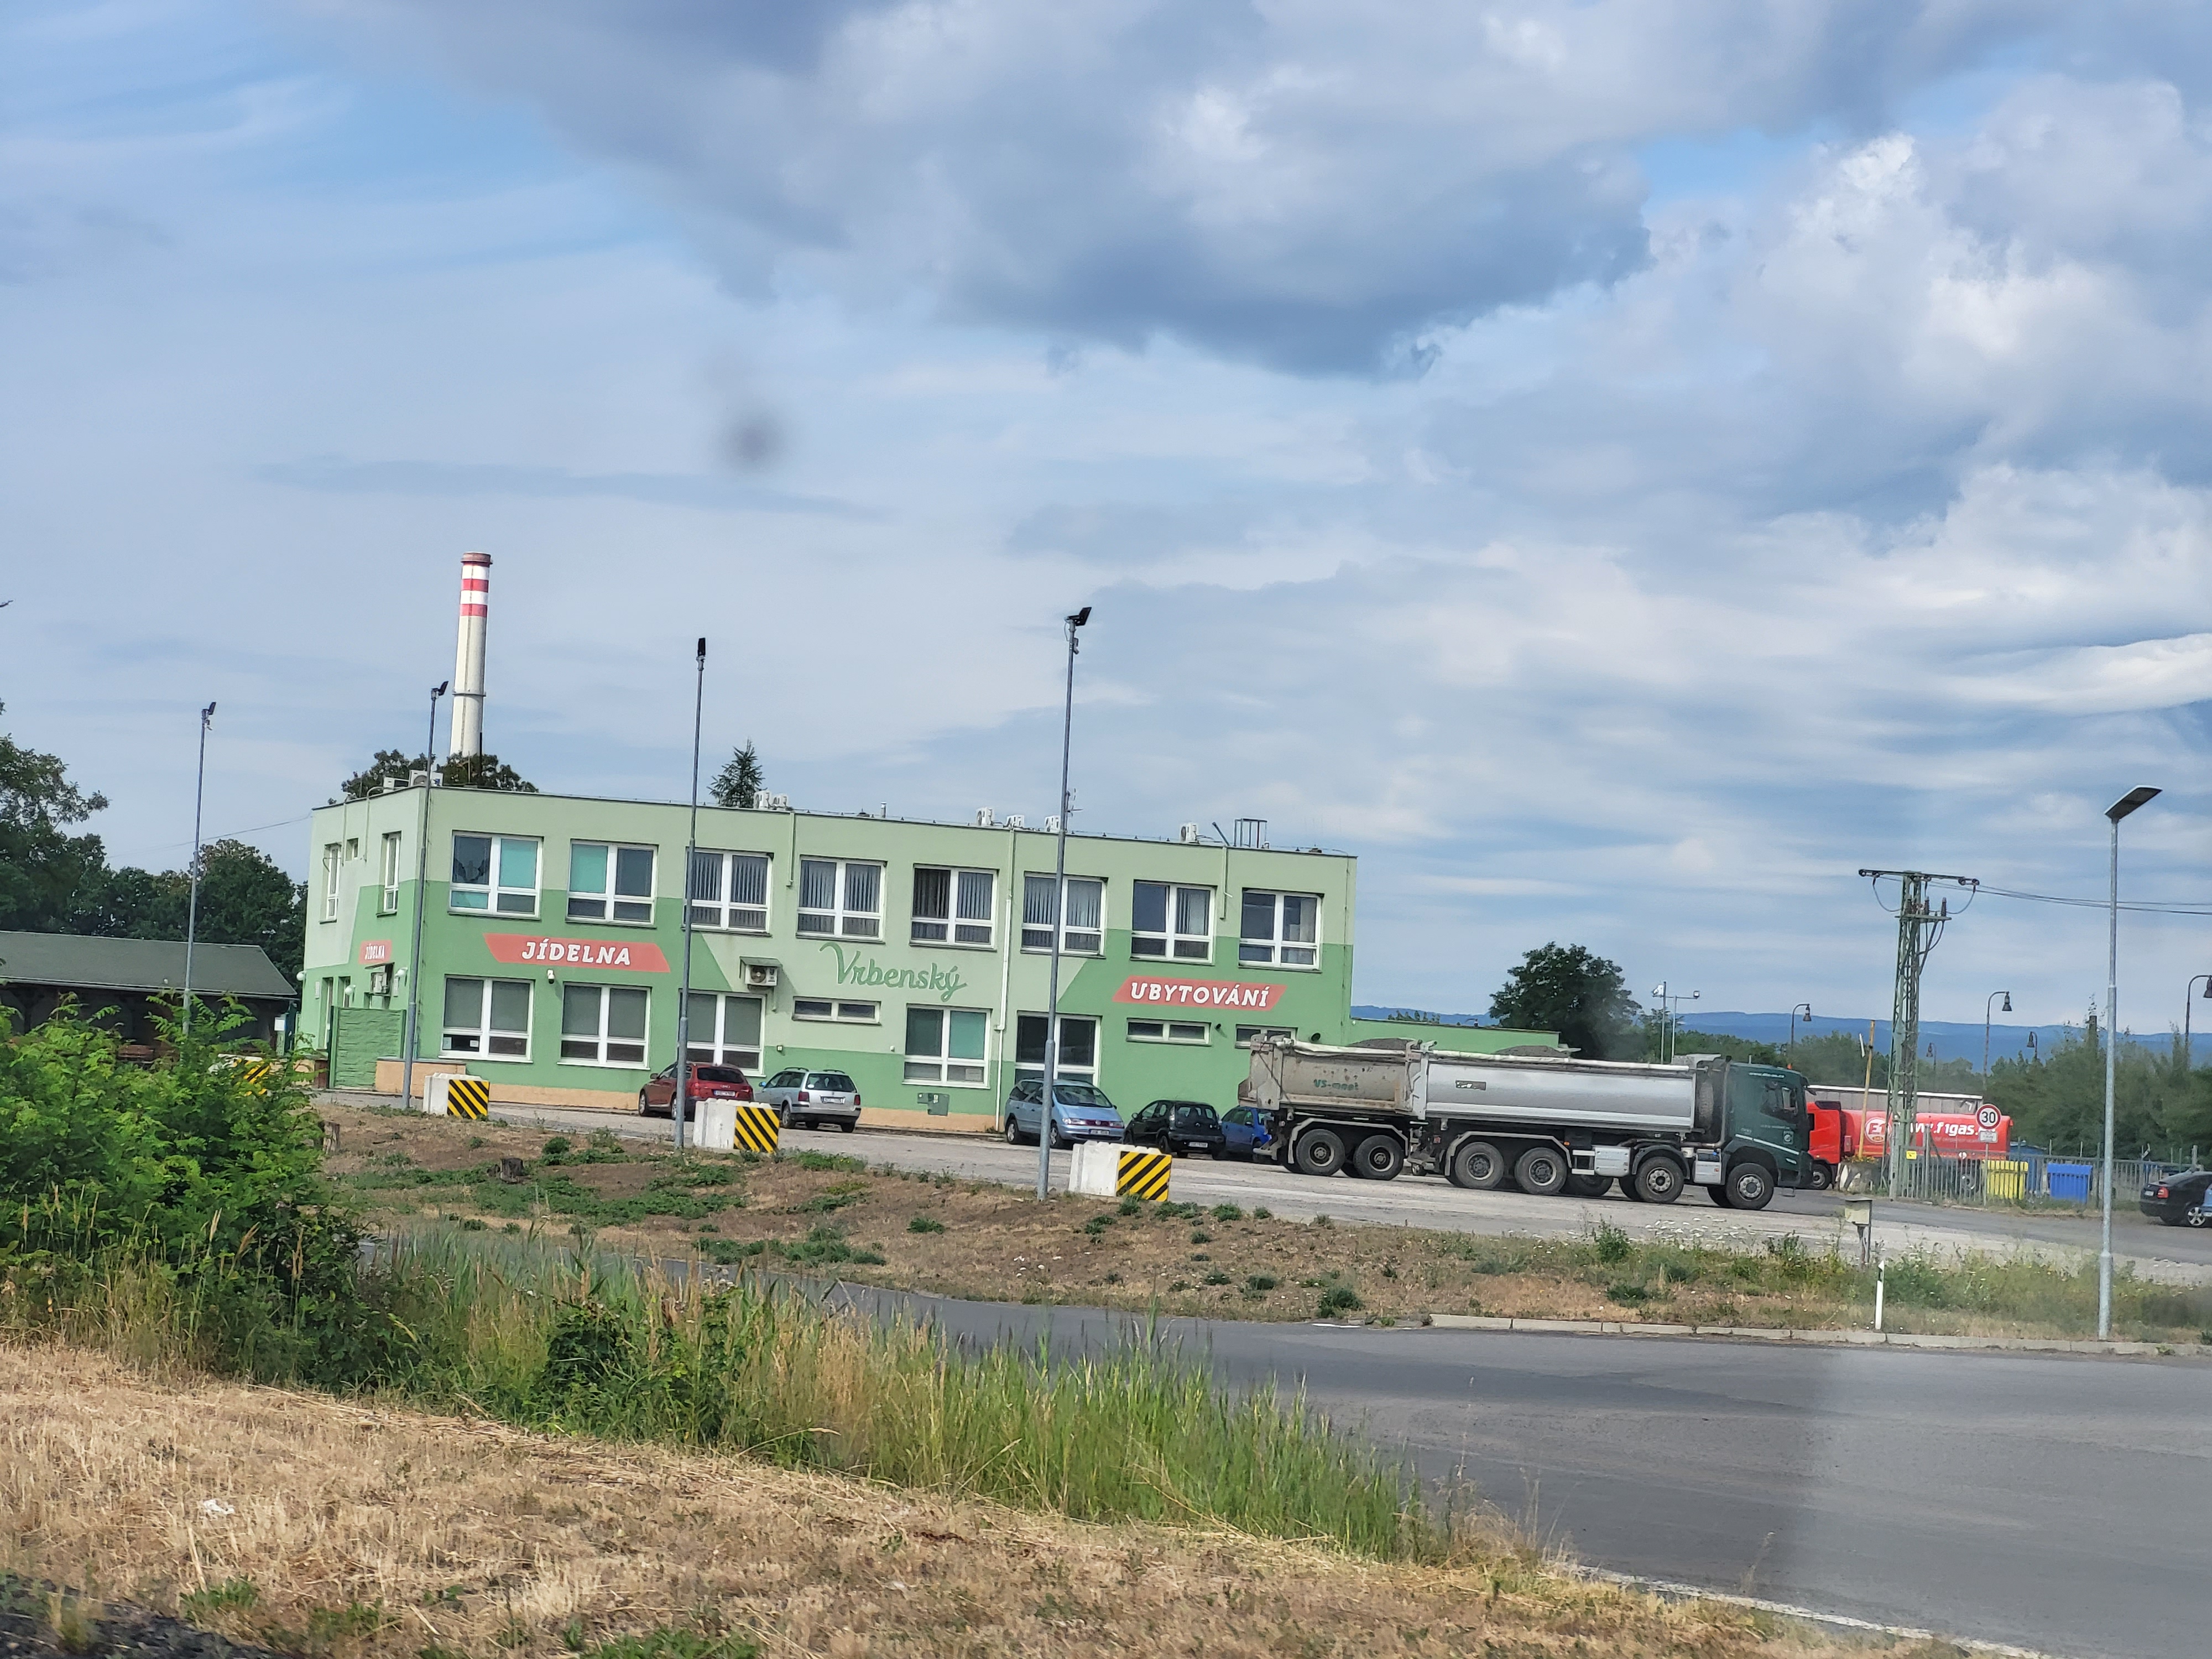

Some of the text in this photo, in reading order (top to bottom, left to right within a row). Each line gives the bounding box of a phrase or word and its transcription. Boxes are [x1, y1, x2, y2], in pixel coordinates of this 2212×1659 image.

[521, 938, 630, 966] JÍDELNA
[819, 942, 968, 1003] Vrbenský
[1131, 982, 1270, 1007] UBYTOVÁNÍ
[1981, 1111, 1996, 1124] 30
